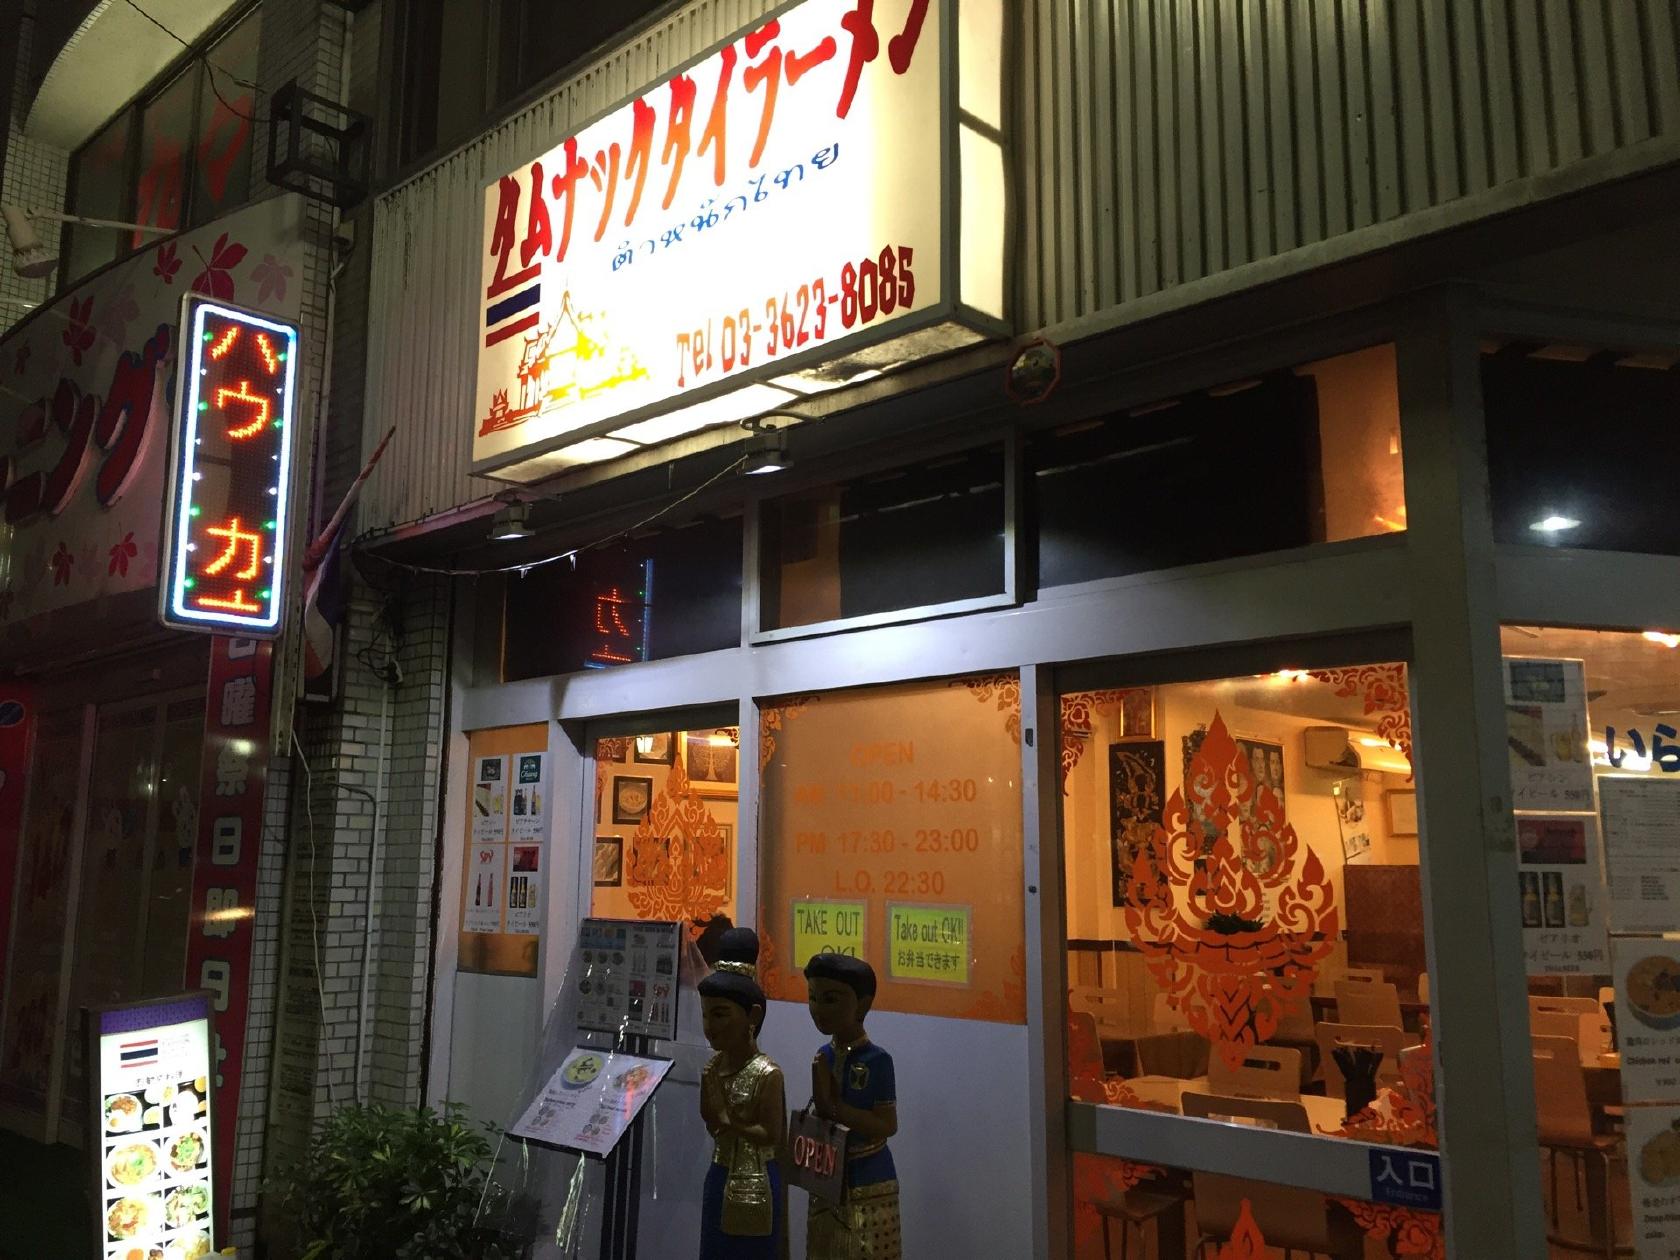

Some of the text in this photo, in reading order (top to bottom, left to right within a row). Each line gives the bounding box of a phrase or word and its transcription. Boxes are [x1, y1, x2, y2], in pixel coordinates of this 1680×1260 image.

[676, 243, 916, 388] Tel 03-3623-8085
[851, 741, 915, 767] OPEN
[915, 778, 977, 802] 14:30
[837, 830, 896, 854] 17:30
[915, 828, 979, 852] 23:00
[836, 870, 945, 896] L.O. 22:30
[797, 909, 860, 937] TAKE OUT
[895, 914, 918, 942] Take
[921, 920, 939, 943] out
[897, 949, 960, 971] お弁当できます
[794, 1135, 838, 1177] OPEN
[1376, 1155, 1435, 1190] 入口
